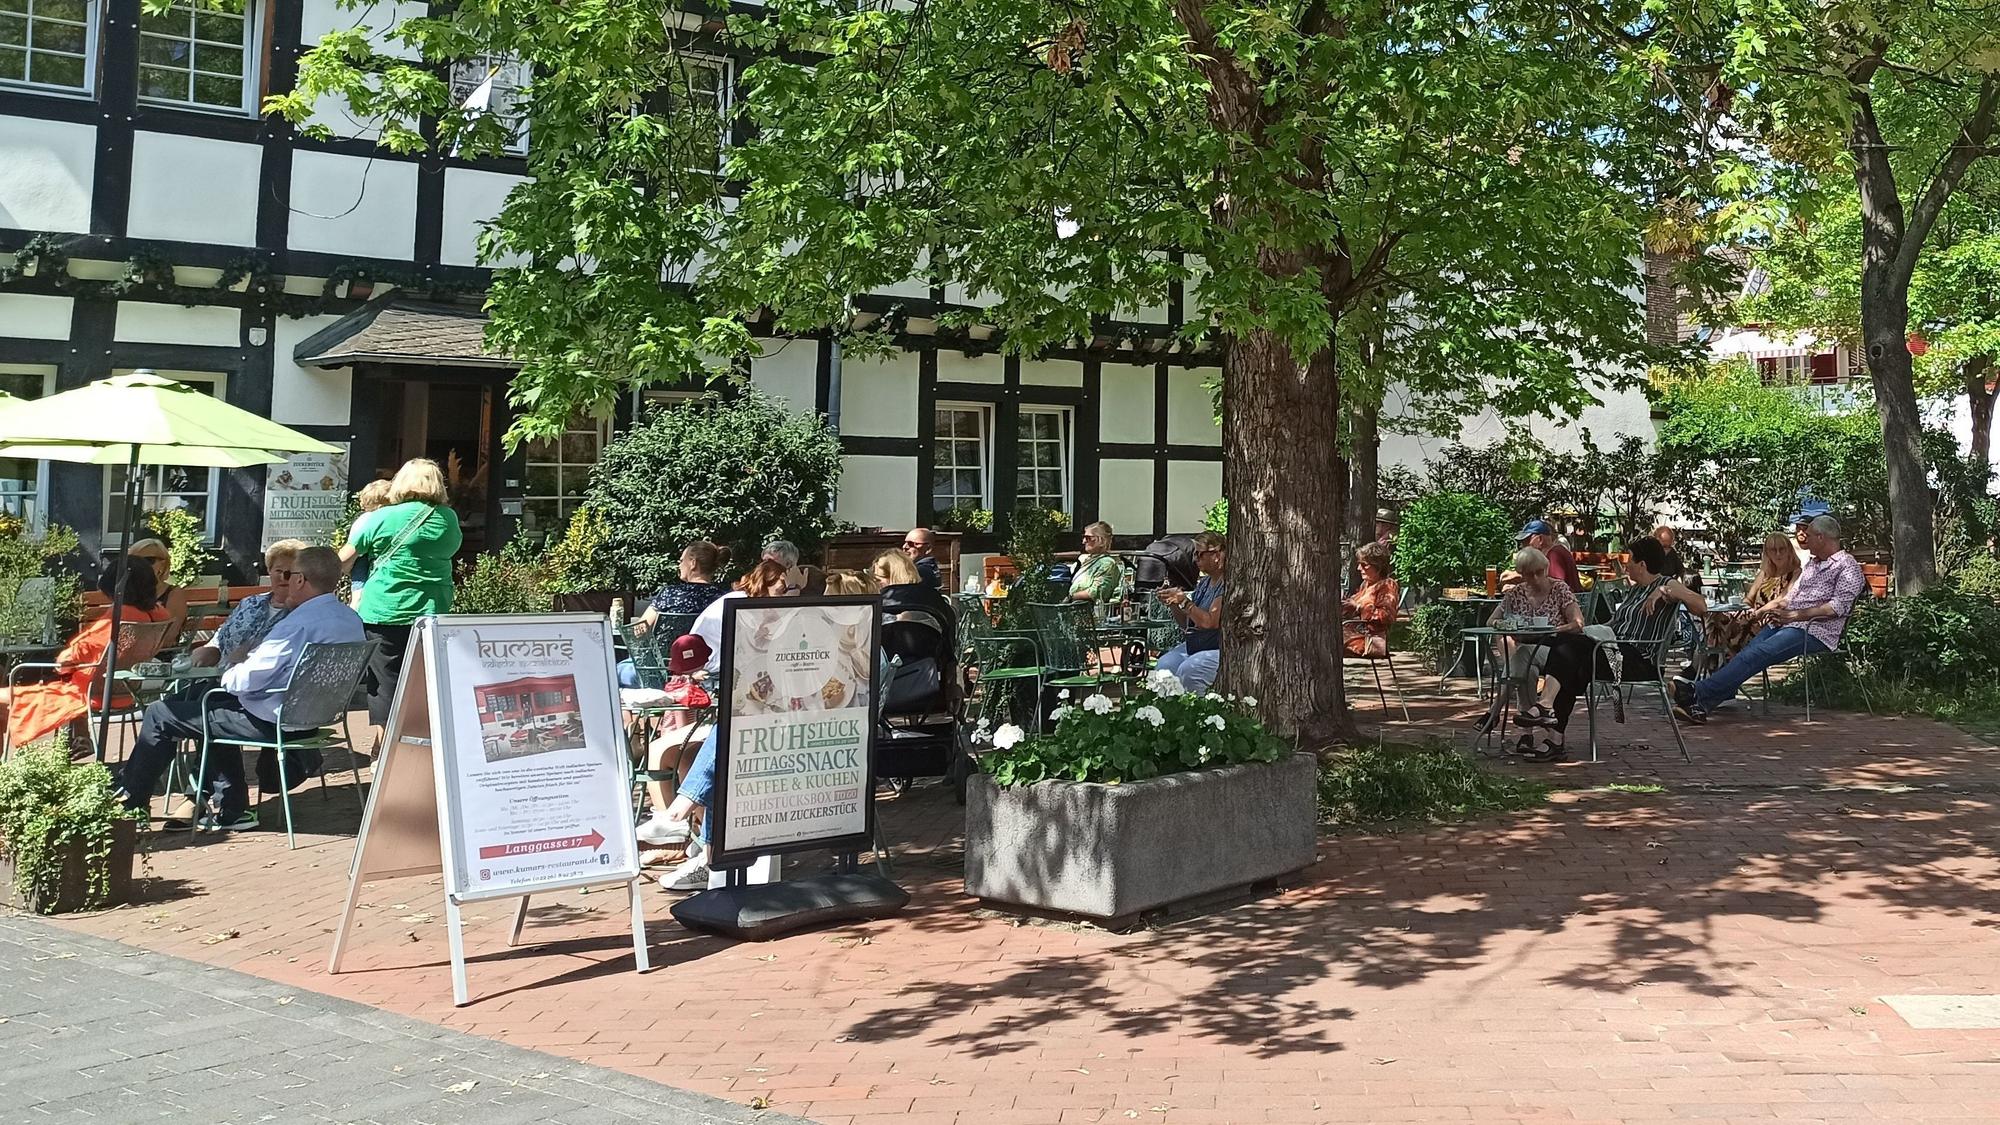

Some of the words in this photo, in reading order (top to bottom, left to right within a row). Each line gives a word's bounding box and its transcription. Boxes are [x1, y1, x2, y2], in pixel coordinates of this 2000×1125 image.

[775, 650, 831, 662] ZUCKERSTÜCK
[735, 778, 788, 798] KAFFEE
[792, 776, 802, 791] &
[806, 770, 859, 789] KUCHEN
[836, 791, 846, 800] TO
[846, 789, 856, 798] GO
[734, 813, 773, 828] FEIERN
[775, 812, 788, 823] IM
[790, 802, 857, 821] ZUCKERSTÜCK
[504, 840, 568, 854] Langgasse
[570, 838, 583, 847] 17
[492, 856, 599, 876] www.kumars-restaurant.de
